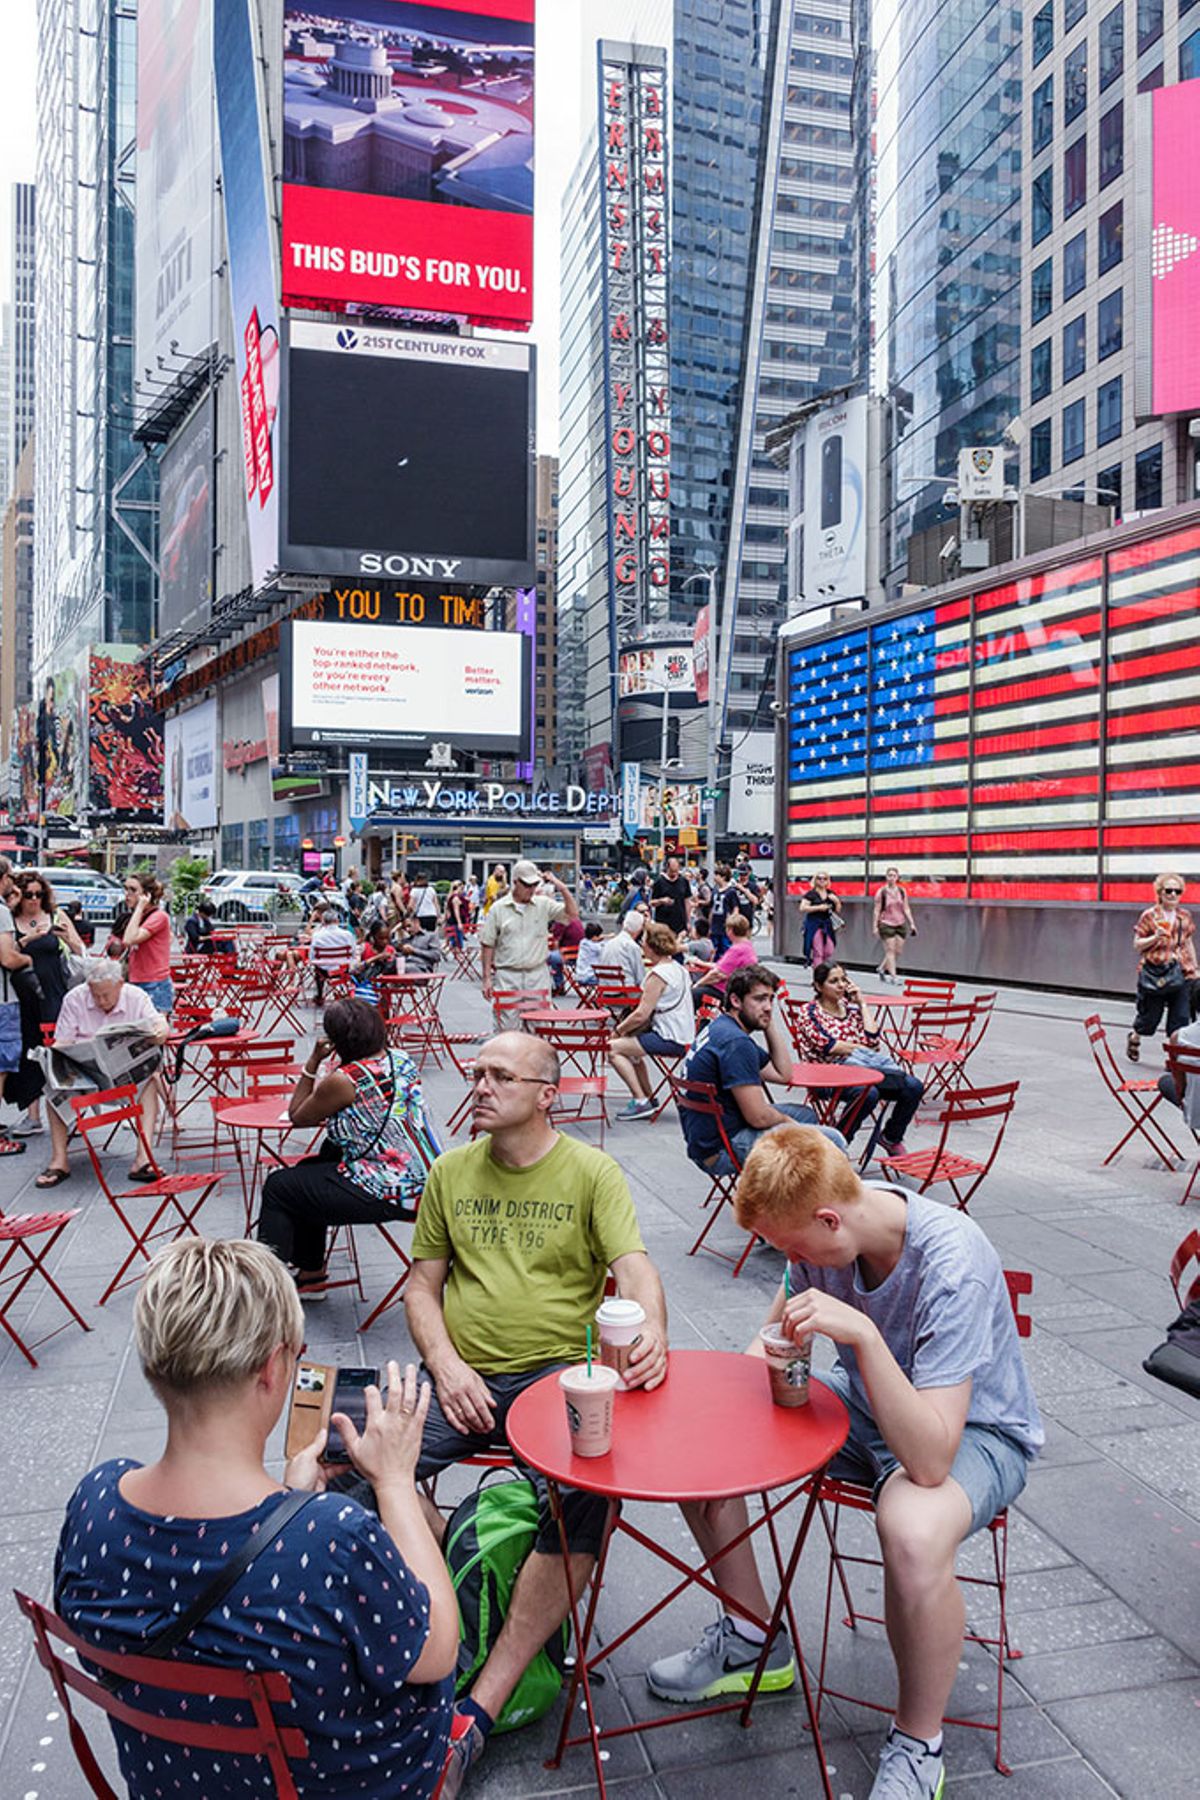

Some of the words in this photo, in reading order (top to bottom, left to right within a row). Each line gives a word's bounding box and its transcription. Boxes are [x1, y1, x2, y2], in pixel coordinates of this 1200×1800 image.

[607, 82, 628, 269] ERNST
[290, 242, 345, 272] THIS
[350, 249, 421, 281] BUD'S
[425, 259, 471, 287] FOR
[475, 264, 527, 294] YOU.
[611, 313, 631, 339] &
[362, 335, 394, 350] 21ST
[394, 339, 456, 356] CENTURY
[459, 346, 485, 359] FOX
[612, 383, 638, 584] YOUNG
[359, 553, 462, 578] SONY
[334, 589, 381, 620] YOU
[395, 592, 425, 623] TO
[313, 646, 346, 657] You're
[348, 649, 379, 659] either
[381, 650, 399, 660] the
[312, 670, 324, 678] or
[326, 671, 359, 681] you're
[361, 674, 391, 684] every
[312, 681, 341, 691] other
[422, 780, 480, 809] YORK
[485, 783, 560, 812] POLICE
[455, 1198, 502, 1217] DENIM
[506, 1200, 575, 1222] DISTRICT
[470, 1226, 508, 1245] TYPE
[519, 1230, 546, 1249] 196
